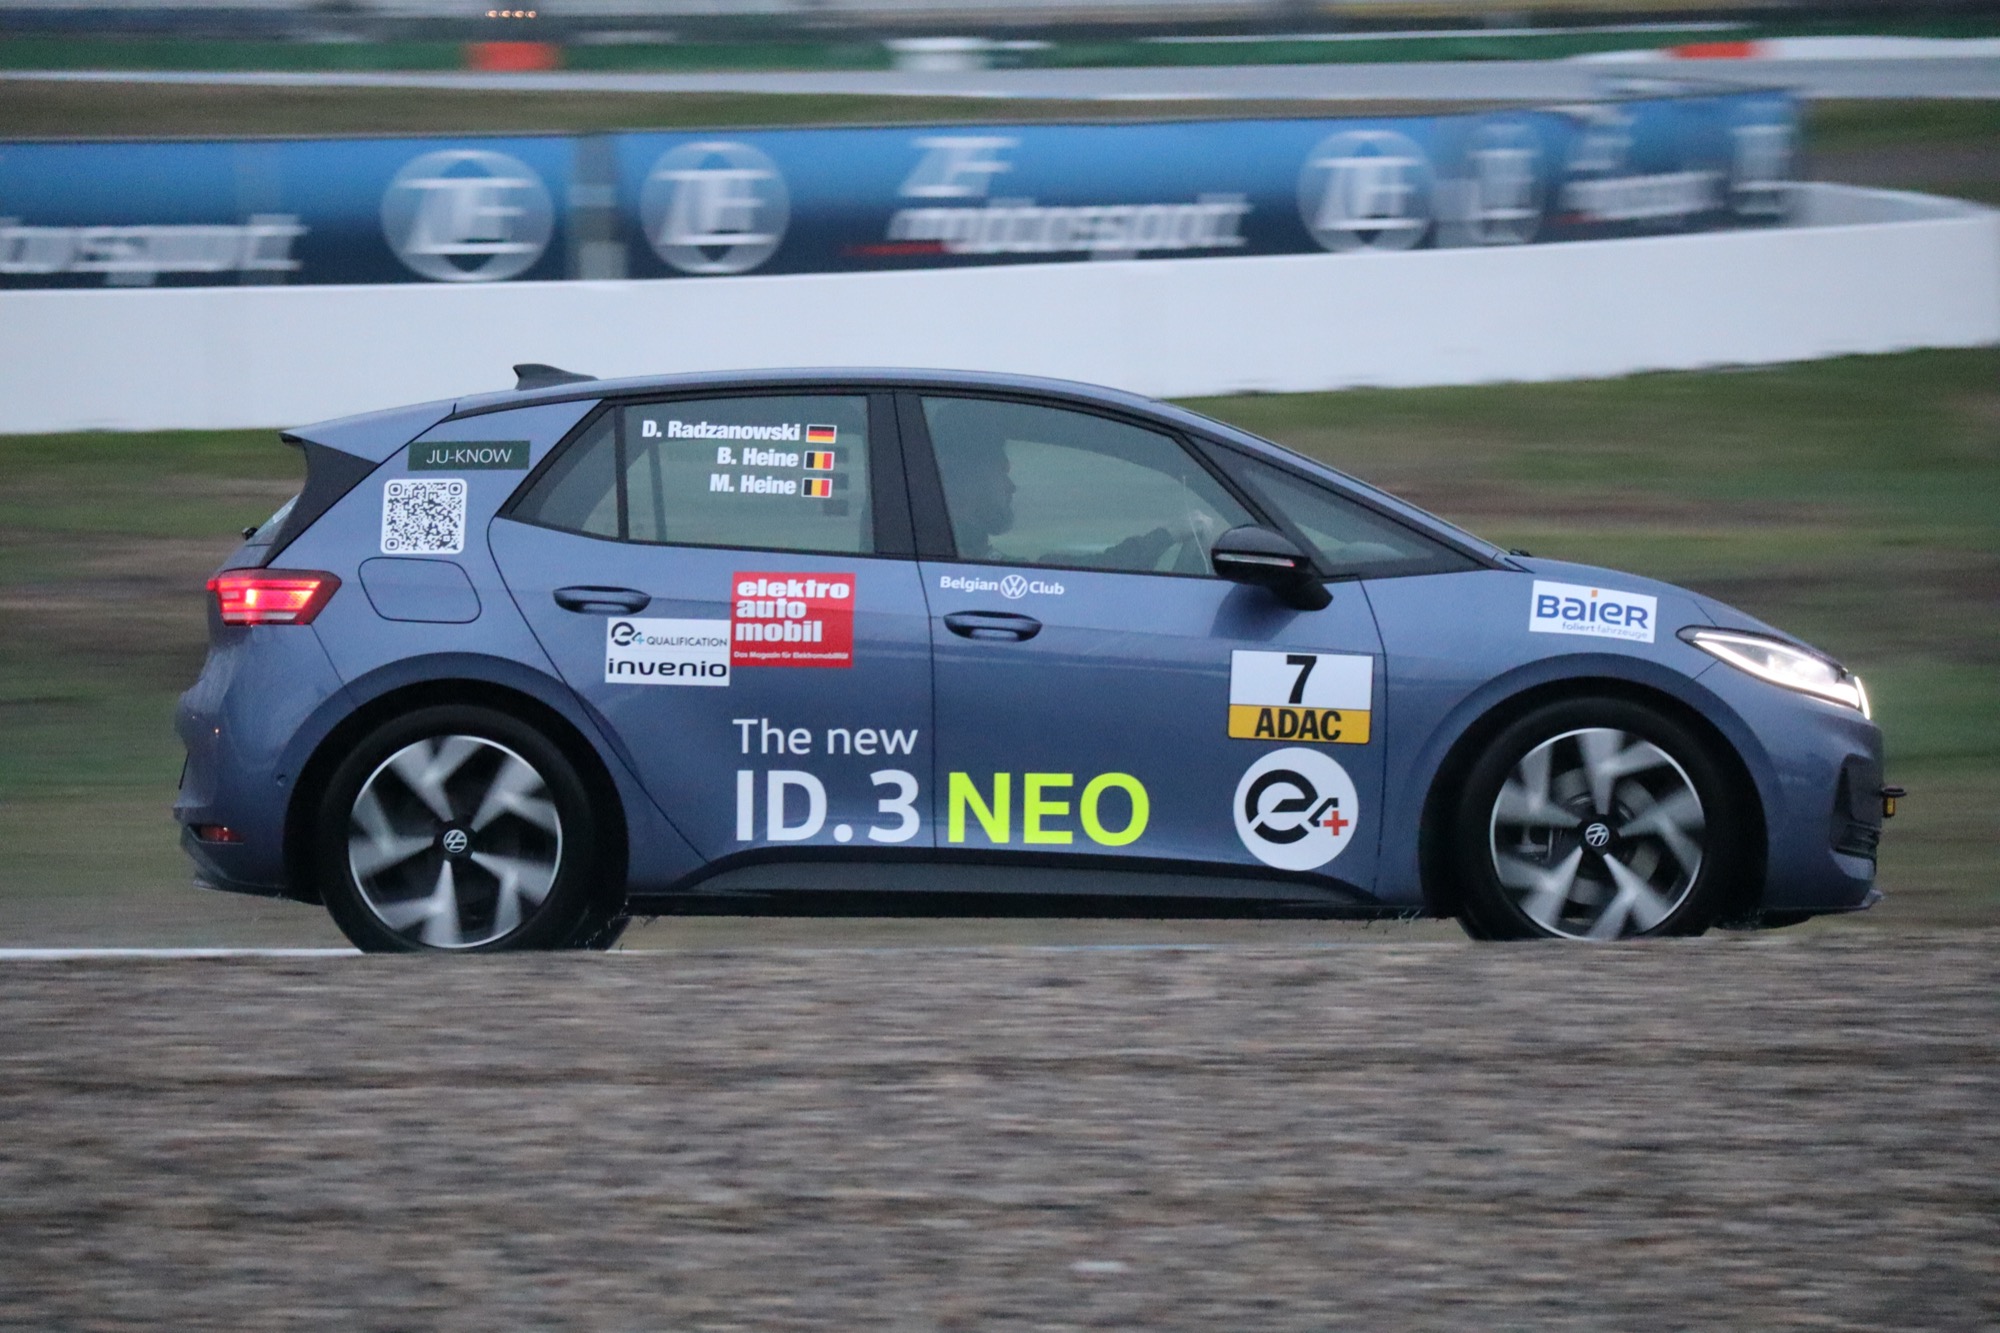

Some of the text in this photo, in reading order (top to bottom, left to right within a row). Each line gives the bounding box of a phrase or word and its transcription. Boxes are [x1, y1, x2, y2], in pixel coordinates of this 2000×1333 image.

[642, 420, 801, 441] D. Radzanowski
[426, 448, 512, 464] JU-KNOW
[717, 447, 799, 467] B. Heine
[709, 474, 797, 494] M. Heine
[737, 579, 850, 599] elektro
[940, 576, 998, 592] Belgian
[1029, 581, 1065, 595] Club
[736, 598, 807, 619] auto
[735, 620, 822, 642] mobil
[1562, 621, 1648, 639] foliert fahrzeuge
[647, 636, 728, 647] QUALIFICATION
[608, 658, 727, 677] invenio
[1286, 654, 1317, 704] 7
[1254, 708, 1342, 741] ADAC
[732, 718, 918, 755] The new
[948, 772, 1150, 846] NEO
